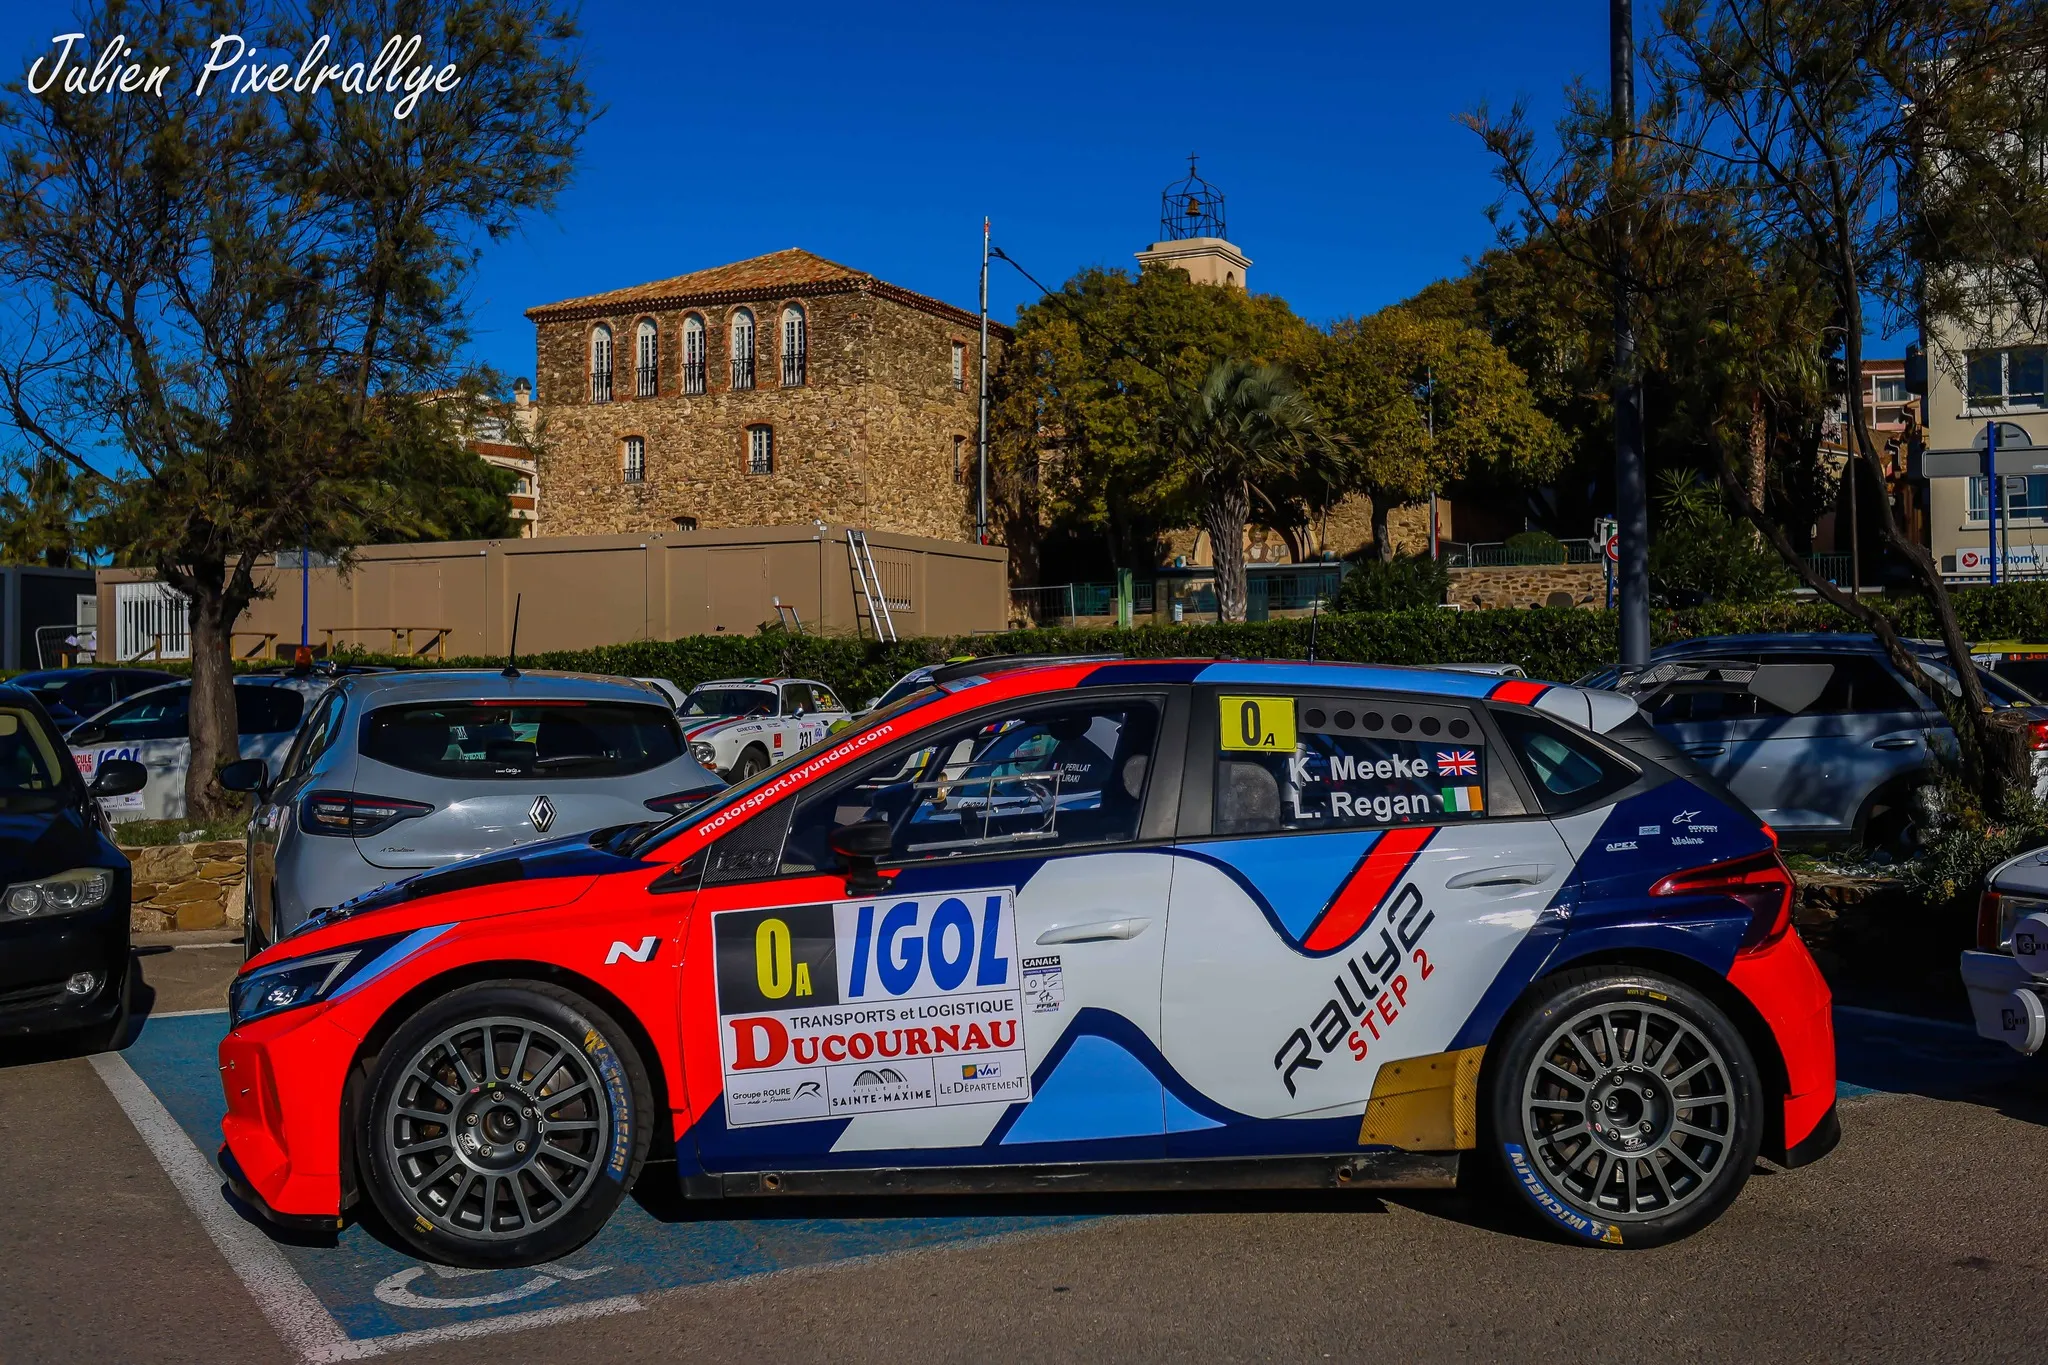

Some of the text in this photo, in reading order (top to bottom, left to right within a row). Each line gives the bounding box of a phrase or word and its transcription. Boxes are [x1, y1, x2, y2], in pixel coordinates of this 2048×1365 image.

[799, 731, 812, 750] 231
[699, 725, 893, 836] motorsport.hyundai.com
[1289, 753, 1429, 782] K. Meeke
[1293, 791, 1430, 822] L. Regan
[1606, 841, 1637, 850] APEX
[848, 896, 1009, 998] IGOL
[1023, 957, 1059, 967] CANAL+
[1274, 882, 1436, 1099] Rally2
[1348, 948, 1435, 1061] STEP 2
[790, 999, 1014, 1029] TRANSPORTS et LOGISTIQUE
[729, 1016, 1017, 1071] DUCOURNAU
[733, 1088, 791, 1100] Groupe ROURE
[832, 1089, 932, 1107] SAINTE-MAXIME
[606, 1067, 630, 1172] MICHELIN
[1510, 1152, 1588, 1231] MICHELIN
